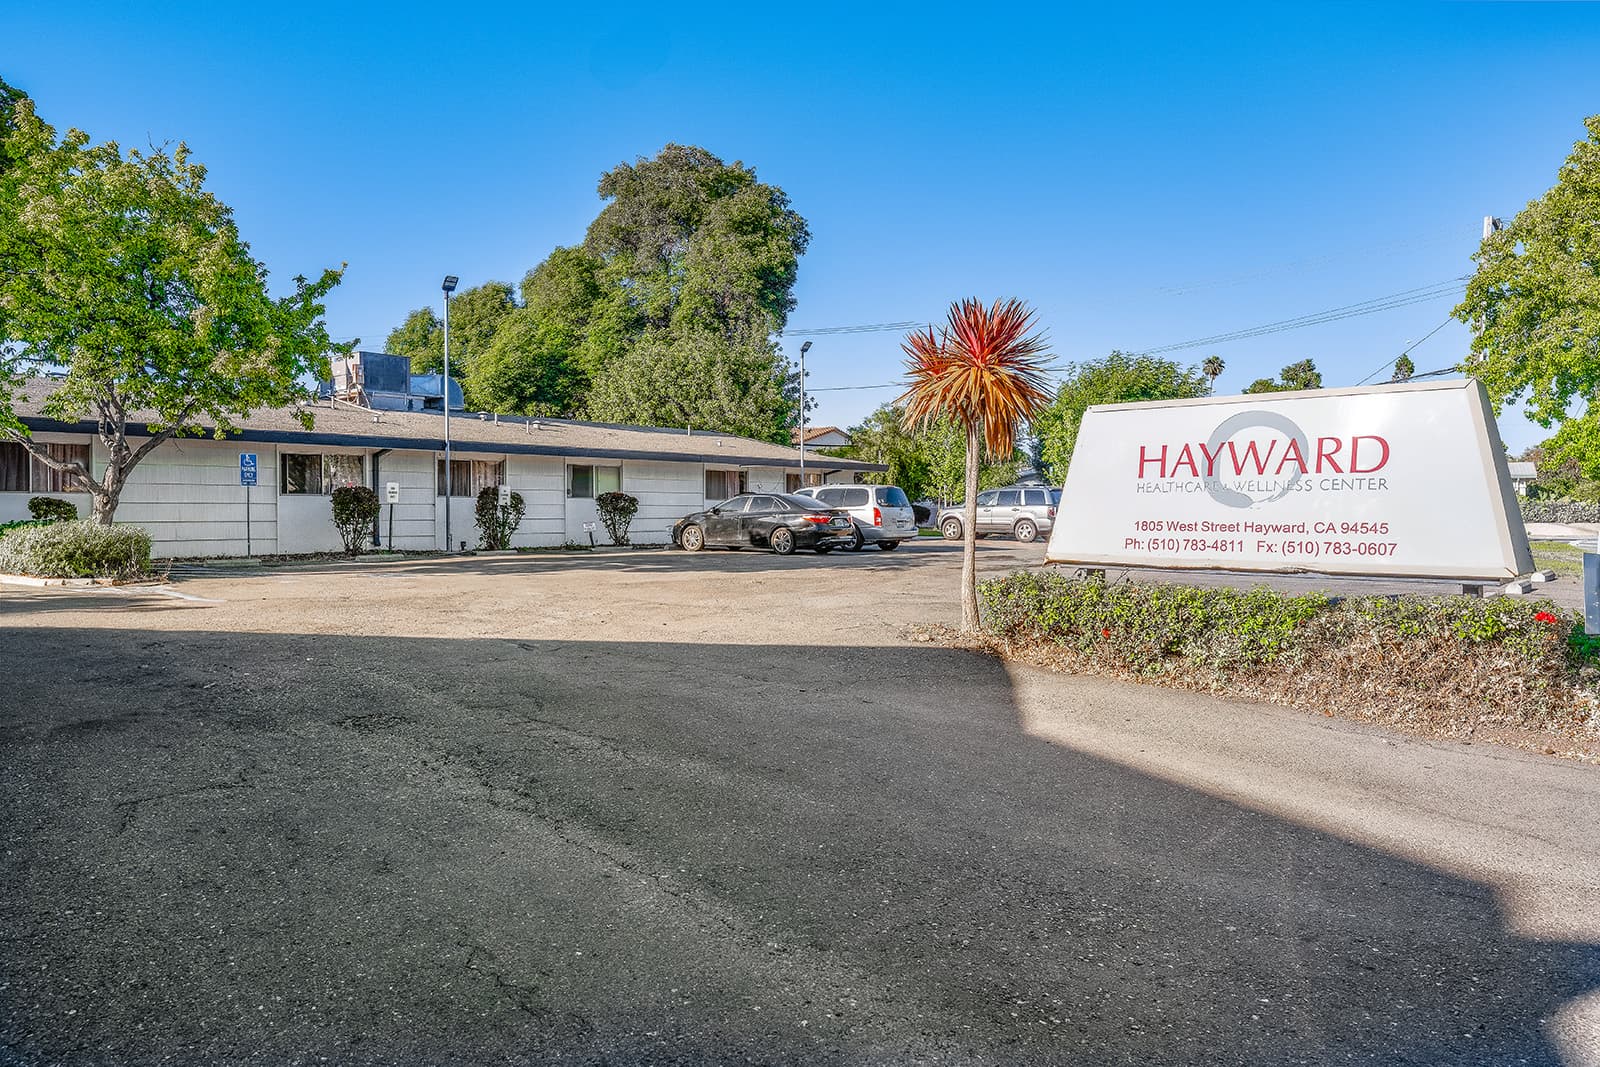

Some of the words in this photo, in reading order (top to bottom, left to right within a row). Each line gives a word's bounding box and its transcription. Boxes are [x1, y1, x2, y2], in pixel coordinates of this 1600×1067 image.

[1138, 435, 1390, 479] HAYWARD
[1136, 481, 1220, 493] HEALTHCARE
[1234, 479, 1313, 492] WELLNESS
[1320, 477, 1389, 491] CENTER
[1134, 520, 1164, 532] 1805
[1166, 521, 1199, 532] West
[1200, 520, 1241, 533] Street
[1244, 521, 1309, 536] Hayward,
[1313, 521, 1337, 534] CA
[1340, 522, 1390, 535] 94545
[1124, 538, 1145, 550] Ph:
[1147, 538, 1180, 553] (510)
[1183, 539, 1244, 552] 783-4811
[1257, 540, 1278, 553] Fx:
[1281, 540, 1320, 557] (510)
[1323, 541, 1398, 556] 783-0607
